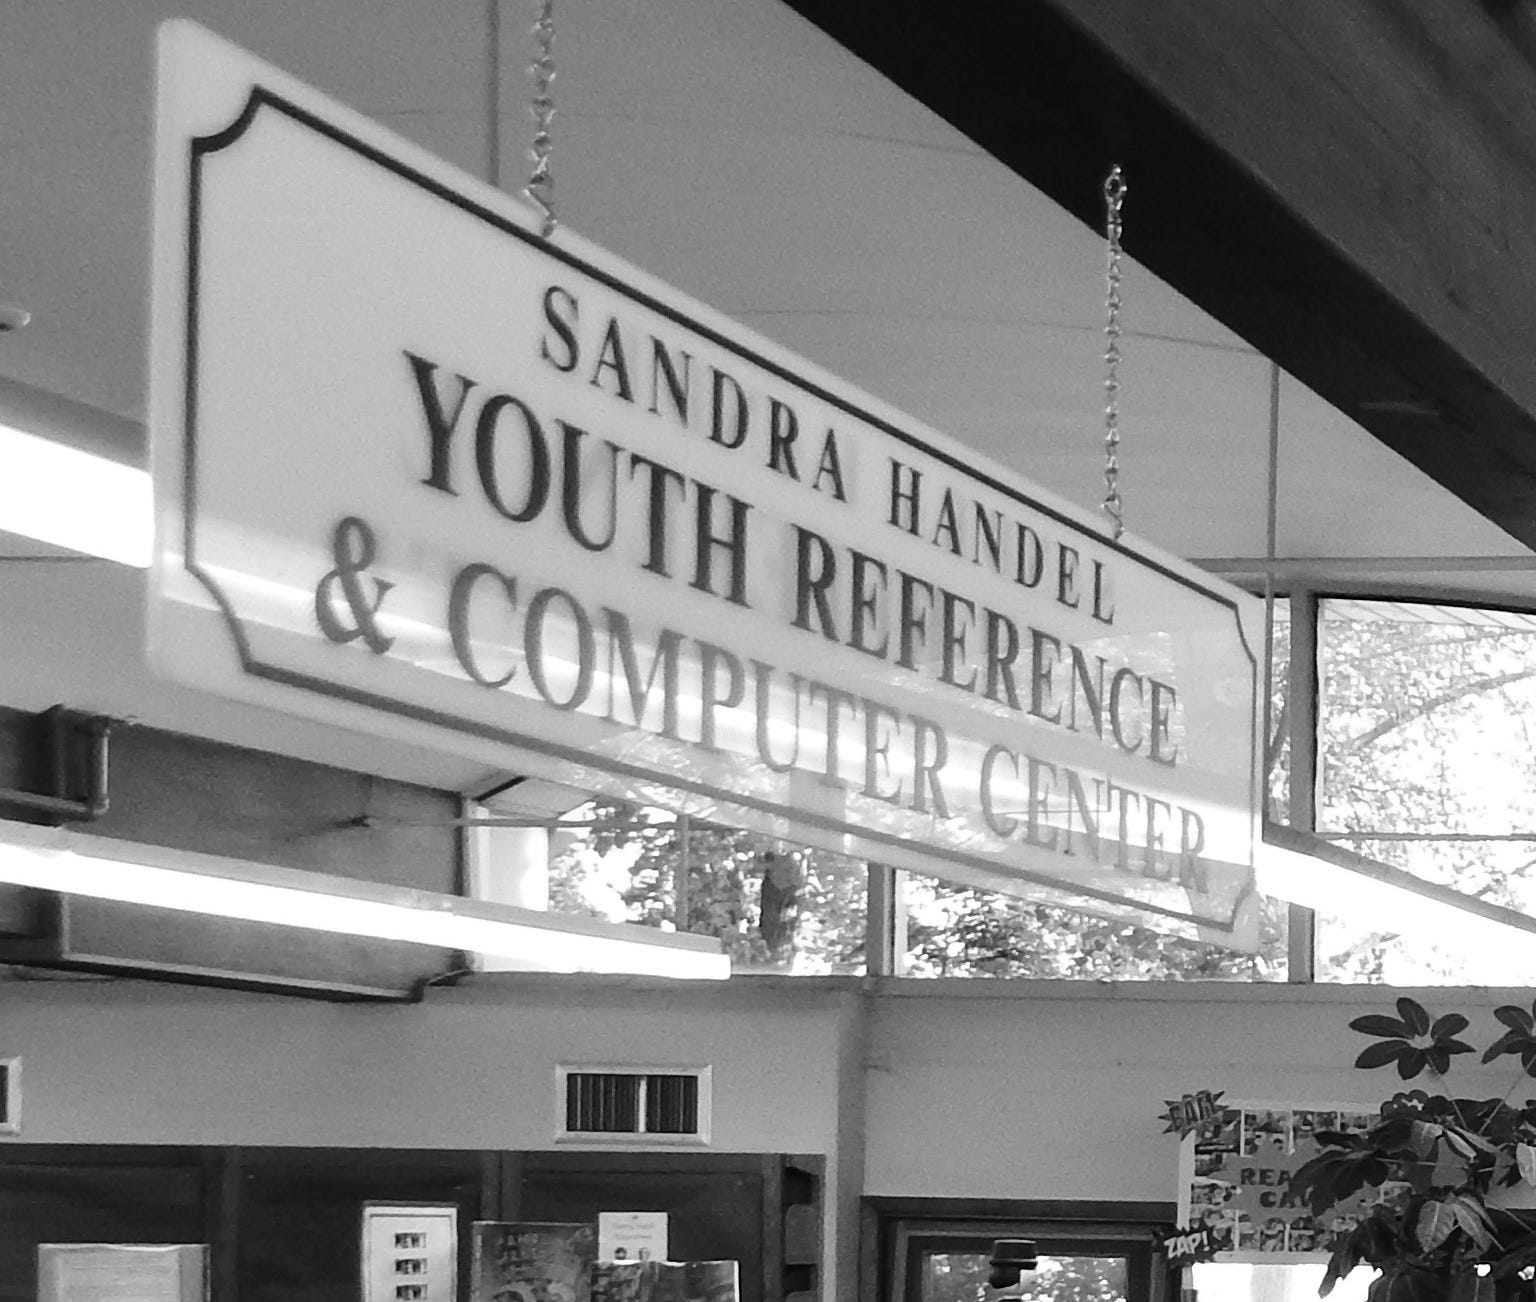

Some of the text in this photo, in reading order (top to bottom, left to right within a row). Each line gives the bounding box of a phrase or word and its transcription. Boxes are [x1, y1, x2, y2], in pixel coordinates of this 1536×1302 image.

[402, 349, 1178, 769] YOUTH REFERENCE
[540, 283, 1117, 627] SANDRA HANDEL
[313, 514, 1206, 880] & COMPUTER CENTER
[1164, 1230, 1210, 1259] ZAP!
